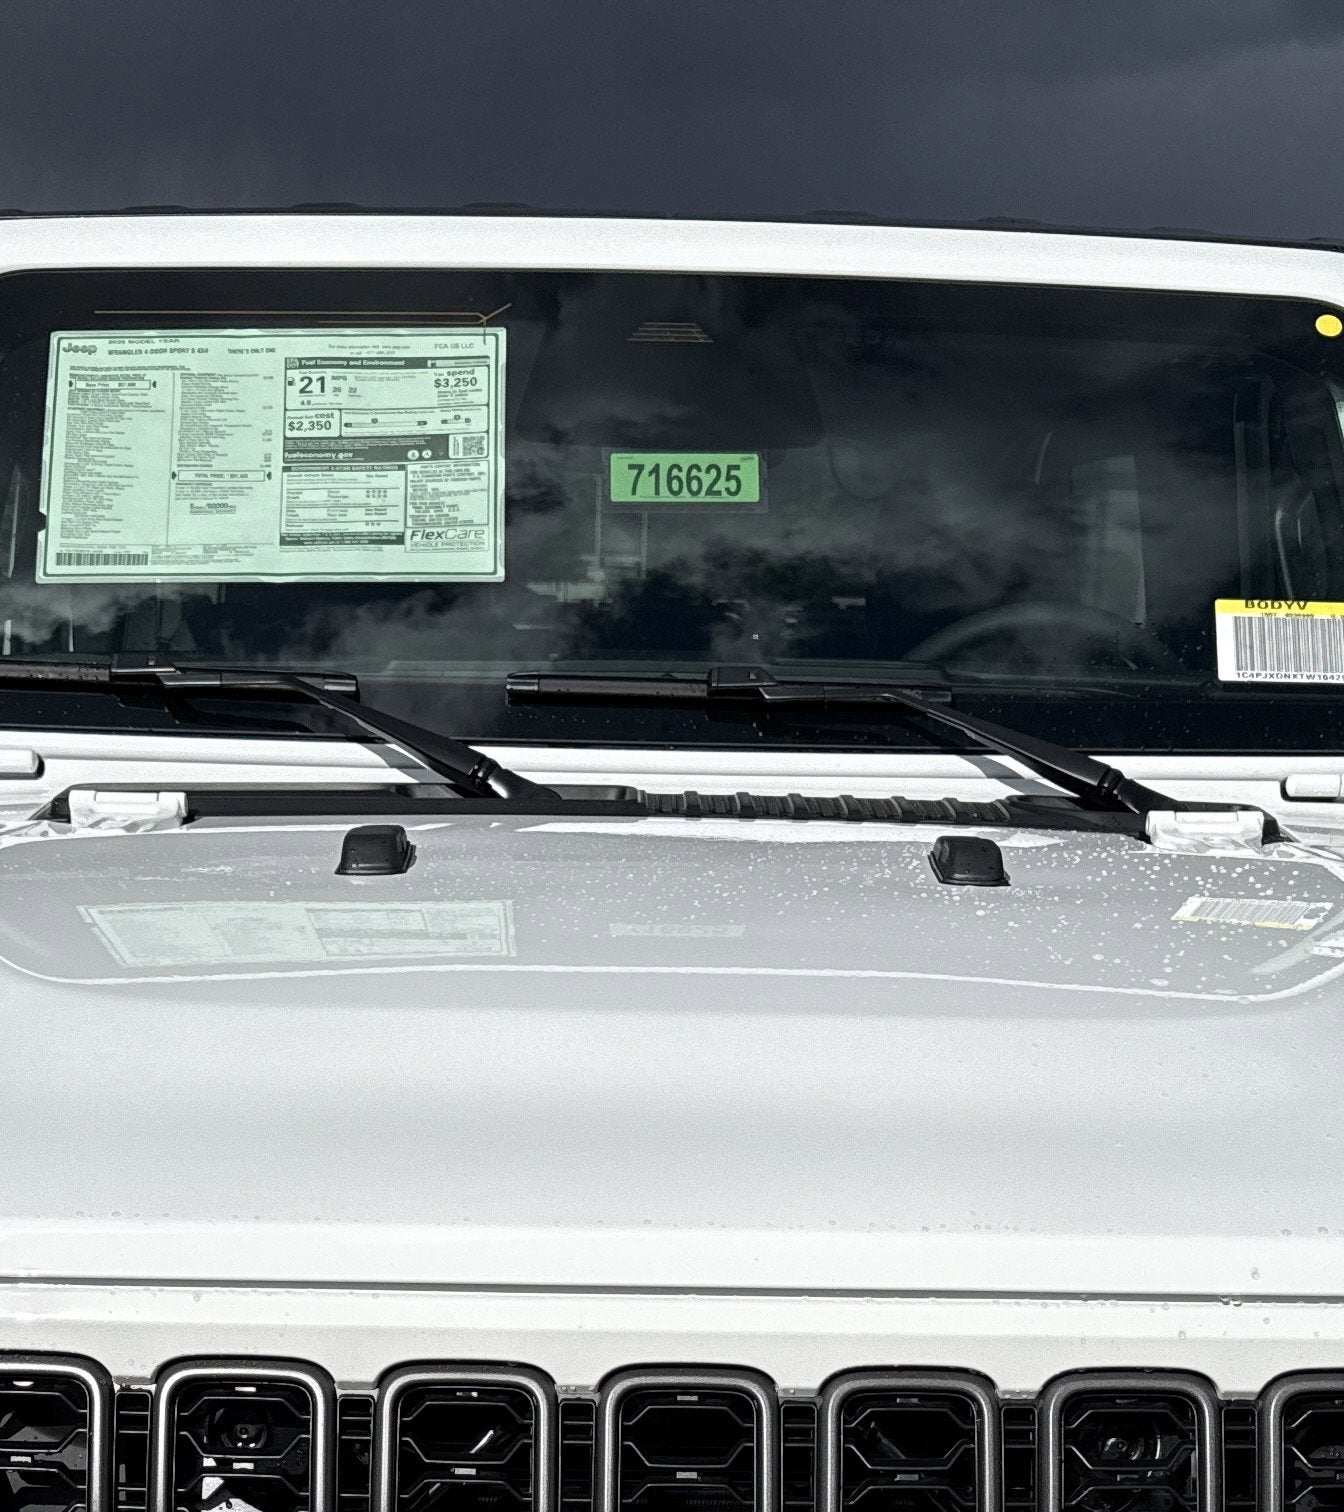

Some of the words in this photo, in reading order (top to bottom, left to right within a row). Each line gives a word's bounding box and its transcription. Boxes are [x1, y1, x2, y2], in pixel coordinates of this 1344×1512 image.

[62, 342, 97, 355] Jeep
[317, 359, 347, 367] Economy
[447, 369, 475, 377] spend
[299, 376, 325, 394] 21
[434, 377, 478, 389] $3,250
[288, 420, 332, 432] $2,350
[284, 452, 354, 460] fueleconomy.gov
[627, 463, 742, 497] 716625
[410, 528, 485, 541] FlexCare
[1244, 600, 1308, 610] BODYV
